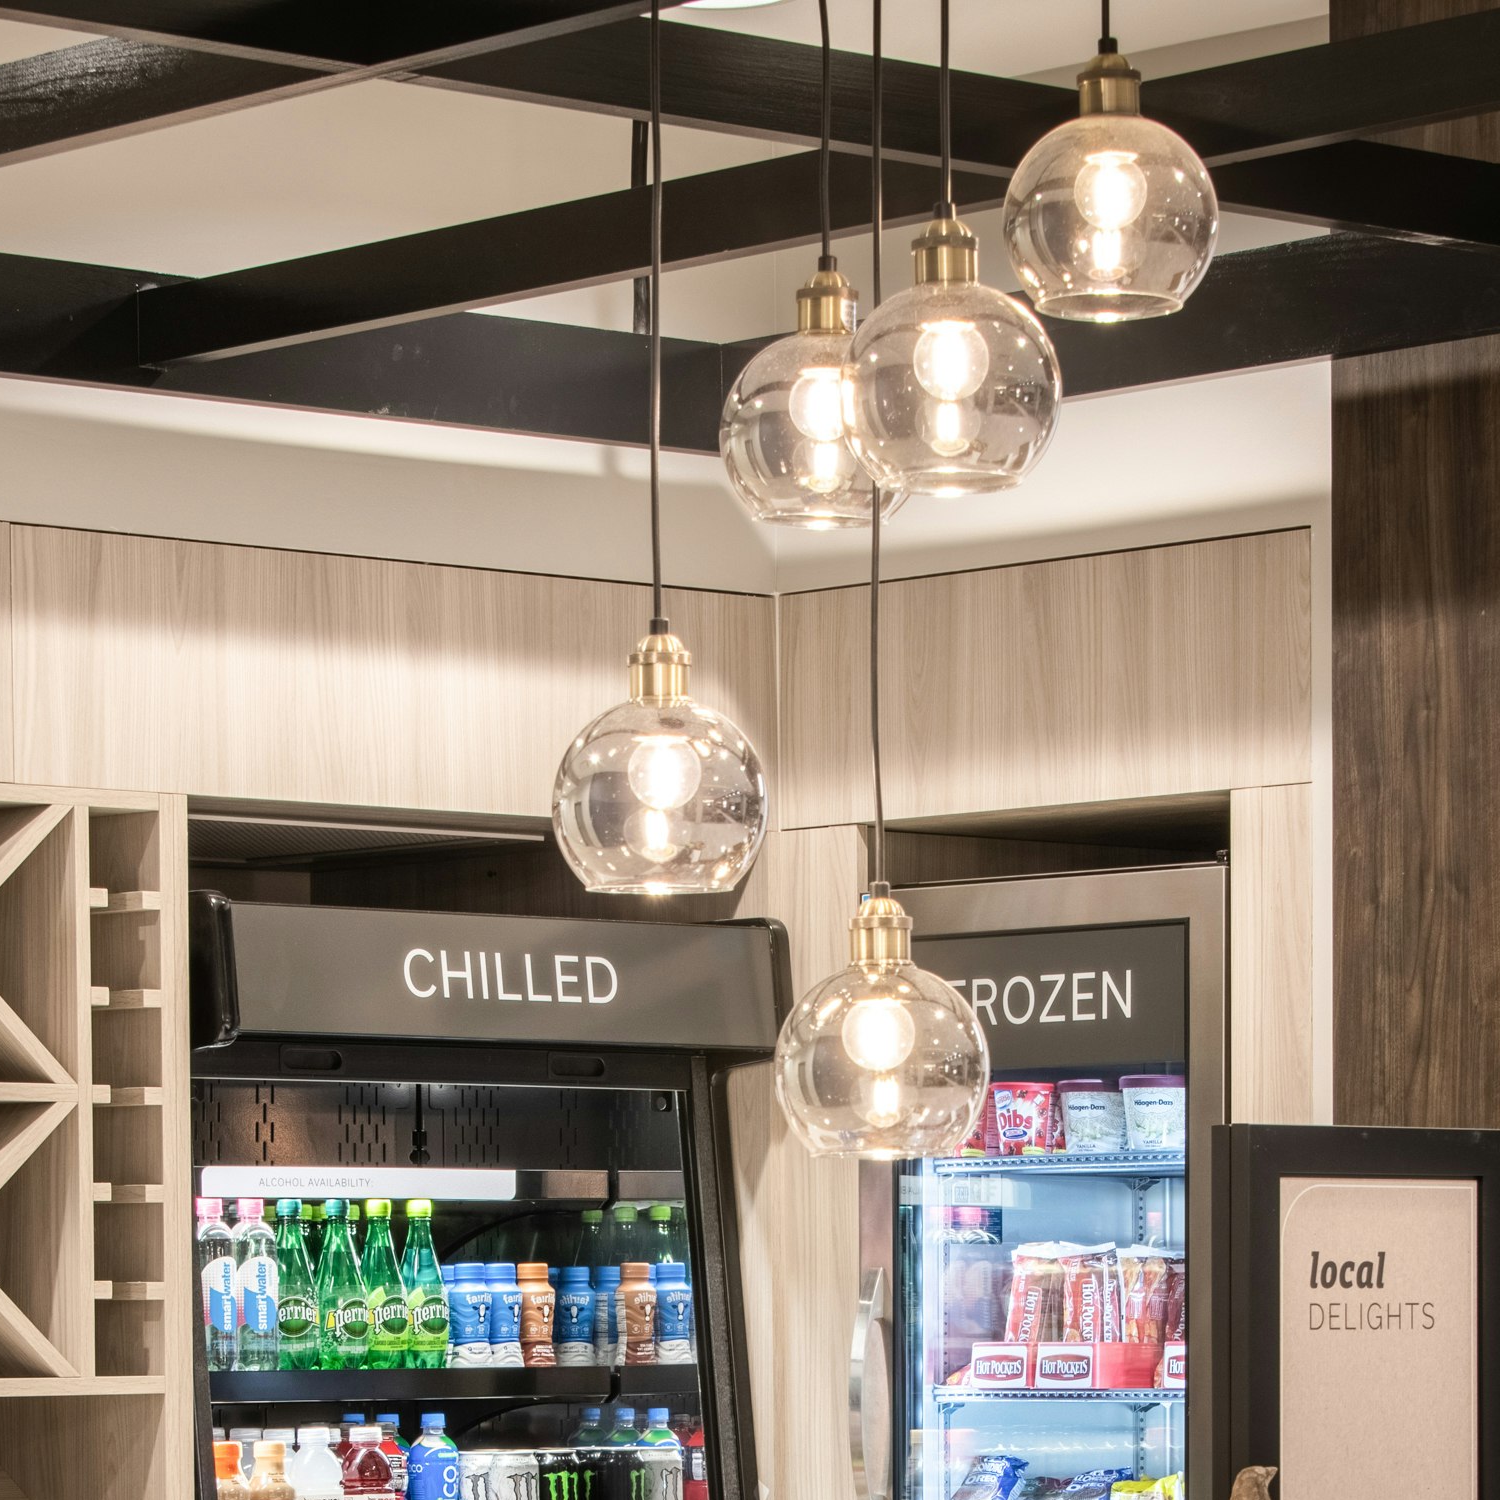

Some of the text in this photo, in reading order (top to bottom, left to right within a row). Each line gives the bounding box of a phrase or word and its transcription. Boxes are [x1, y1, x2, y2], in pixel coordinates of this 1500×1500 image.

[403, 948, 618, 1004] CHILLED
[999, 1107, 1034, 1130] Dibs
[259, 1178, 305, 1187] ALCOHOL
[1310, 1251, 1386, 1289] local
[1309, 1302, 1435, 1330] DELIGHTS
[976, 1360, 1021, 1375] HOT POCKETS
[1042, 1359, 1088, 1374] HOT POCKETS
